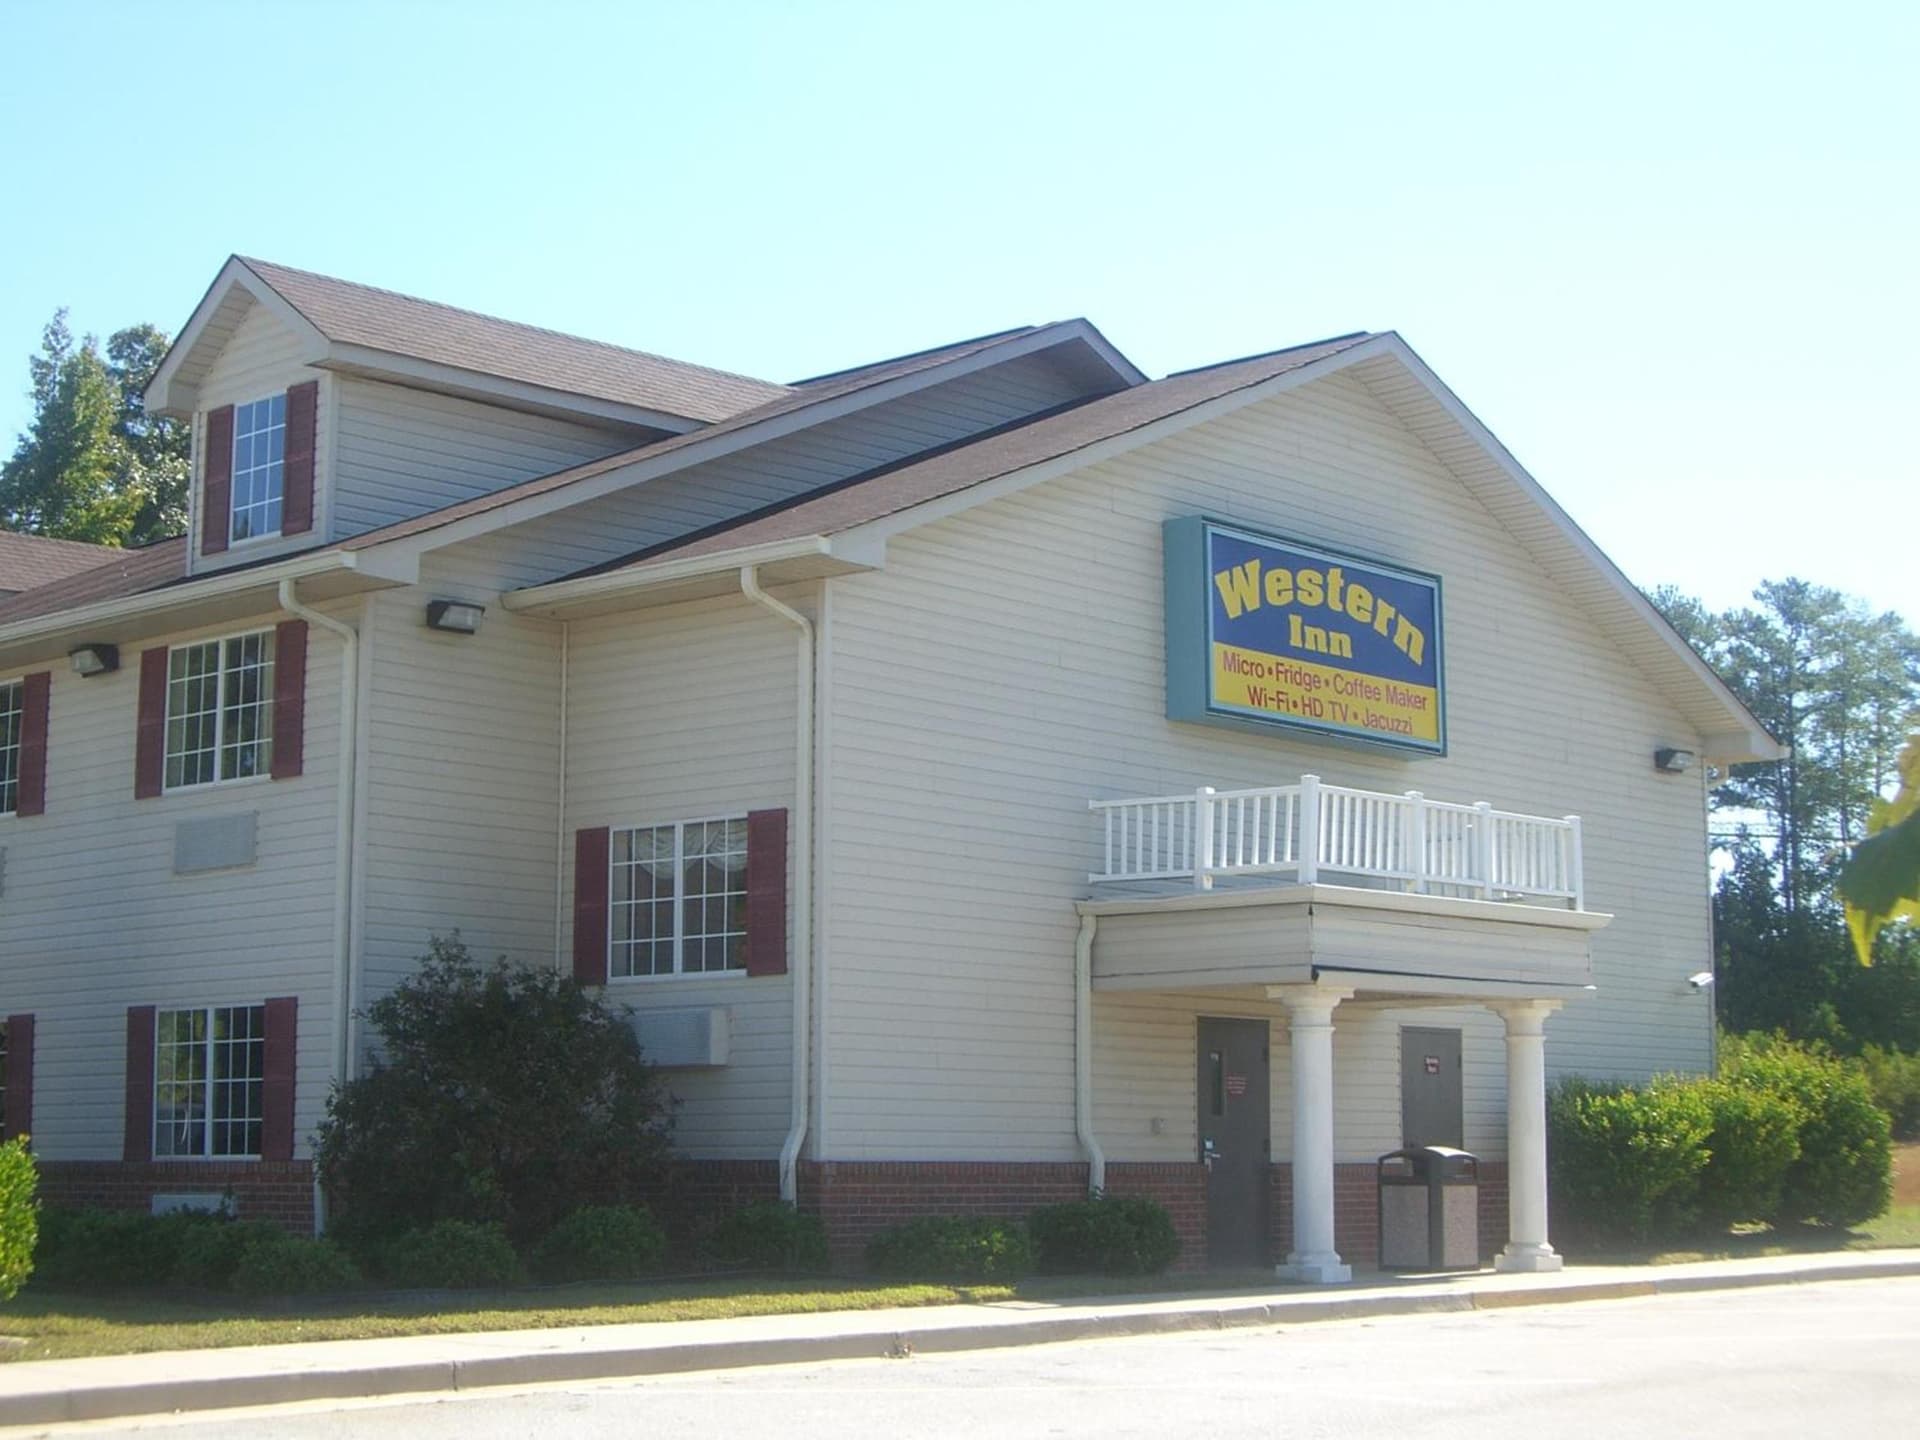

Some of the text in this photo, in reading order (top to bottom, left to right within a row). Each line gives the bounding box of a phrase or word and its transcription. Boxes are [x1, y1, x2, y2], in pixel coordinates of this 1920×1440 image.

[1215, 559, 1425, 666] Western
[1289, 614, 1352, 658] Inn
[1223, 650, 1427, 711] Micro Fridge Coffee Maker
[1247, 684, 1413, 736] Wi-Fi HD TV Jacuzzi
